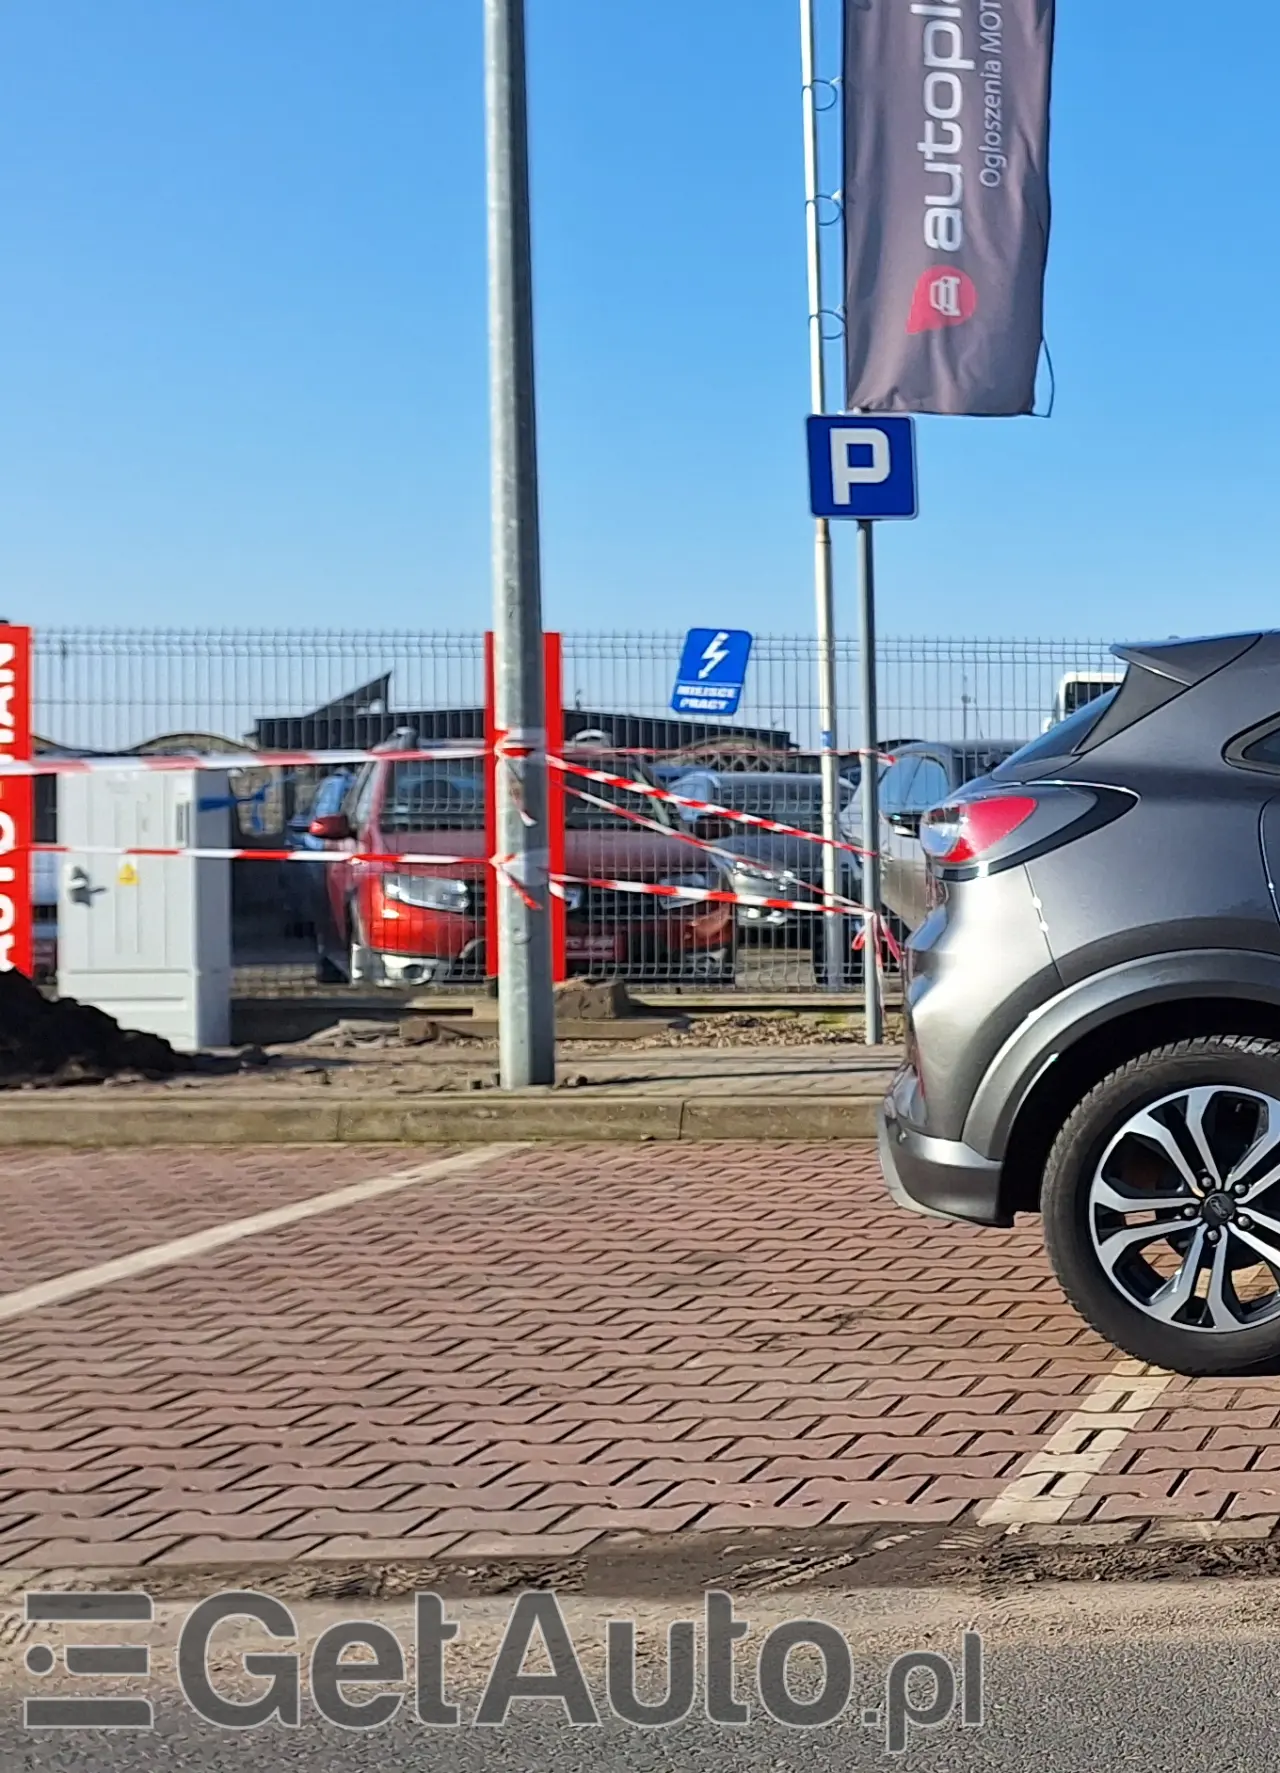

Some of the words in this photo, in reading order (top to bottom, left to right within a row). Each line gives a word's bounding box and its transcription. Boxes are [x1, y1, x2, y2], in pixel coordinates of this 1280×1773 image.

[909, 0, 976, 253] autopl
[979, 59, 1009, 189] Ogłoszenia
[829, 427, 892, 505] P
